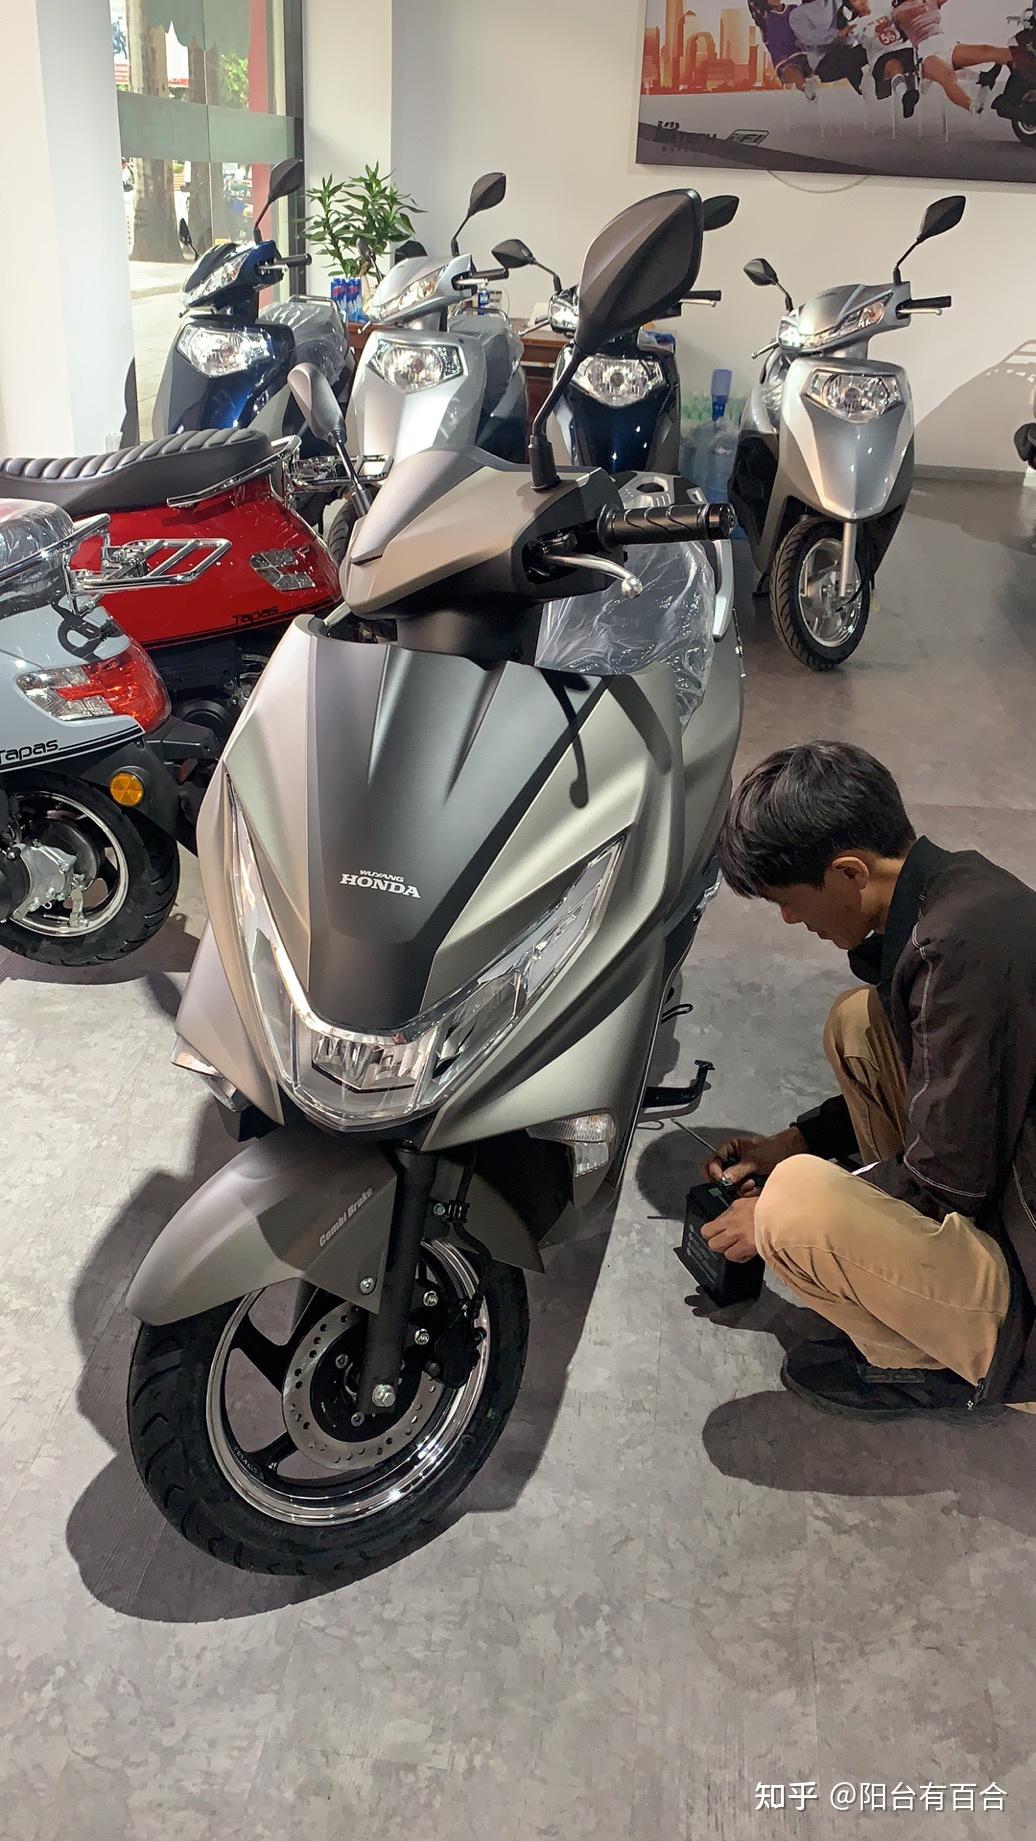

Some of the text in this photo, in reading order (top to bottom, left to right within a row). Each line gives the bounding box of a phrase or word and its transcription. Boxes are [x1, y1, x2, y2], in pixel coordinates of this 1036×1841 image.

[231, 606, 279, 626] Tapas
[340, 873, 421, 899] HONDA
[360, 869, 405, 883] WUYANG
[319, 1187, 373, 1248] Combi Brake
